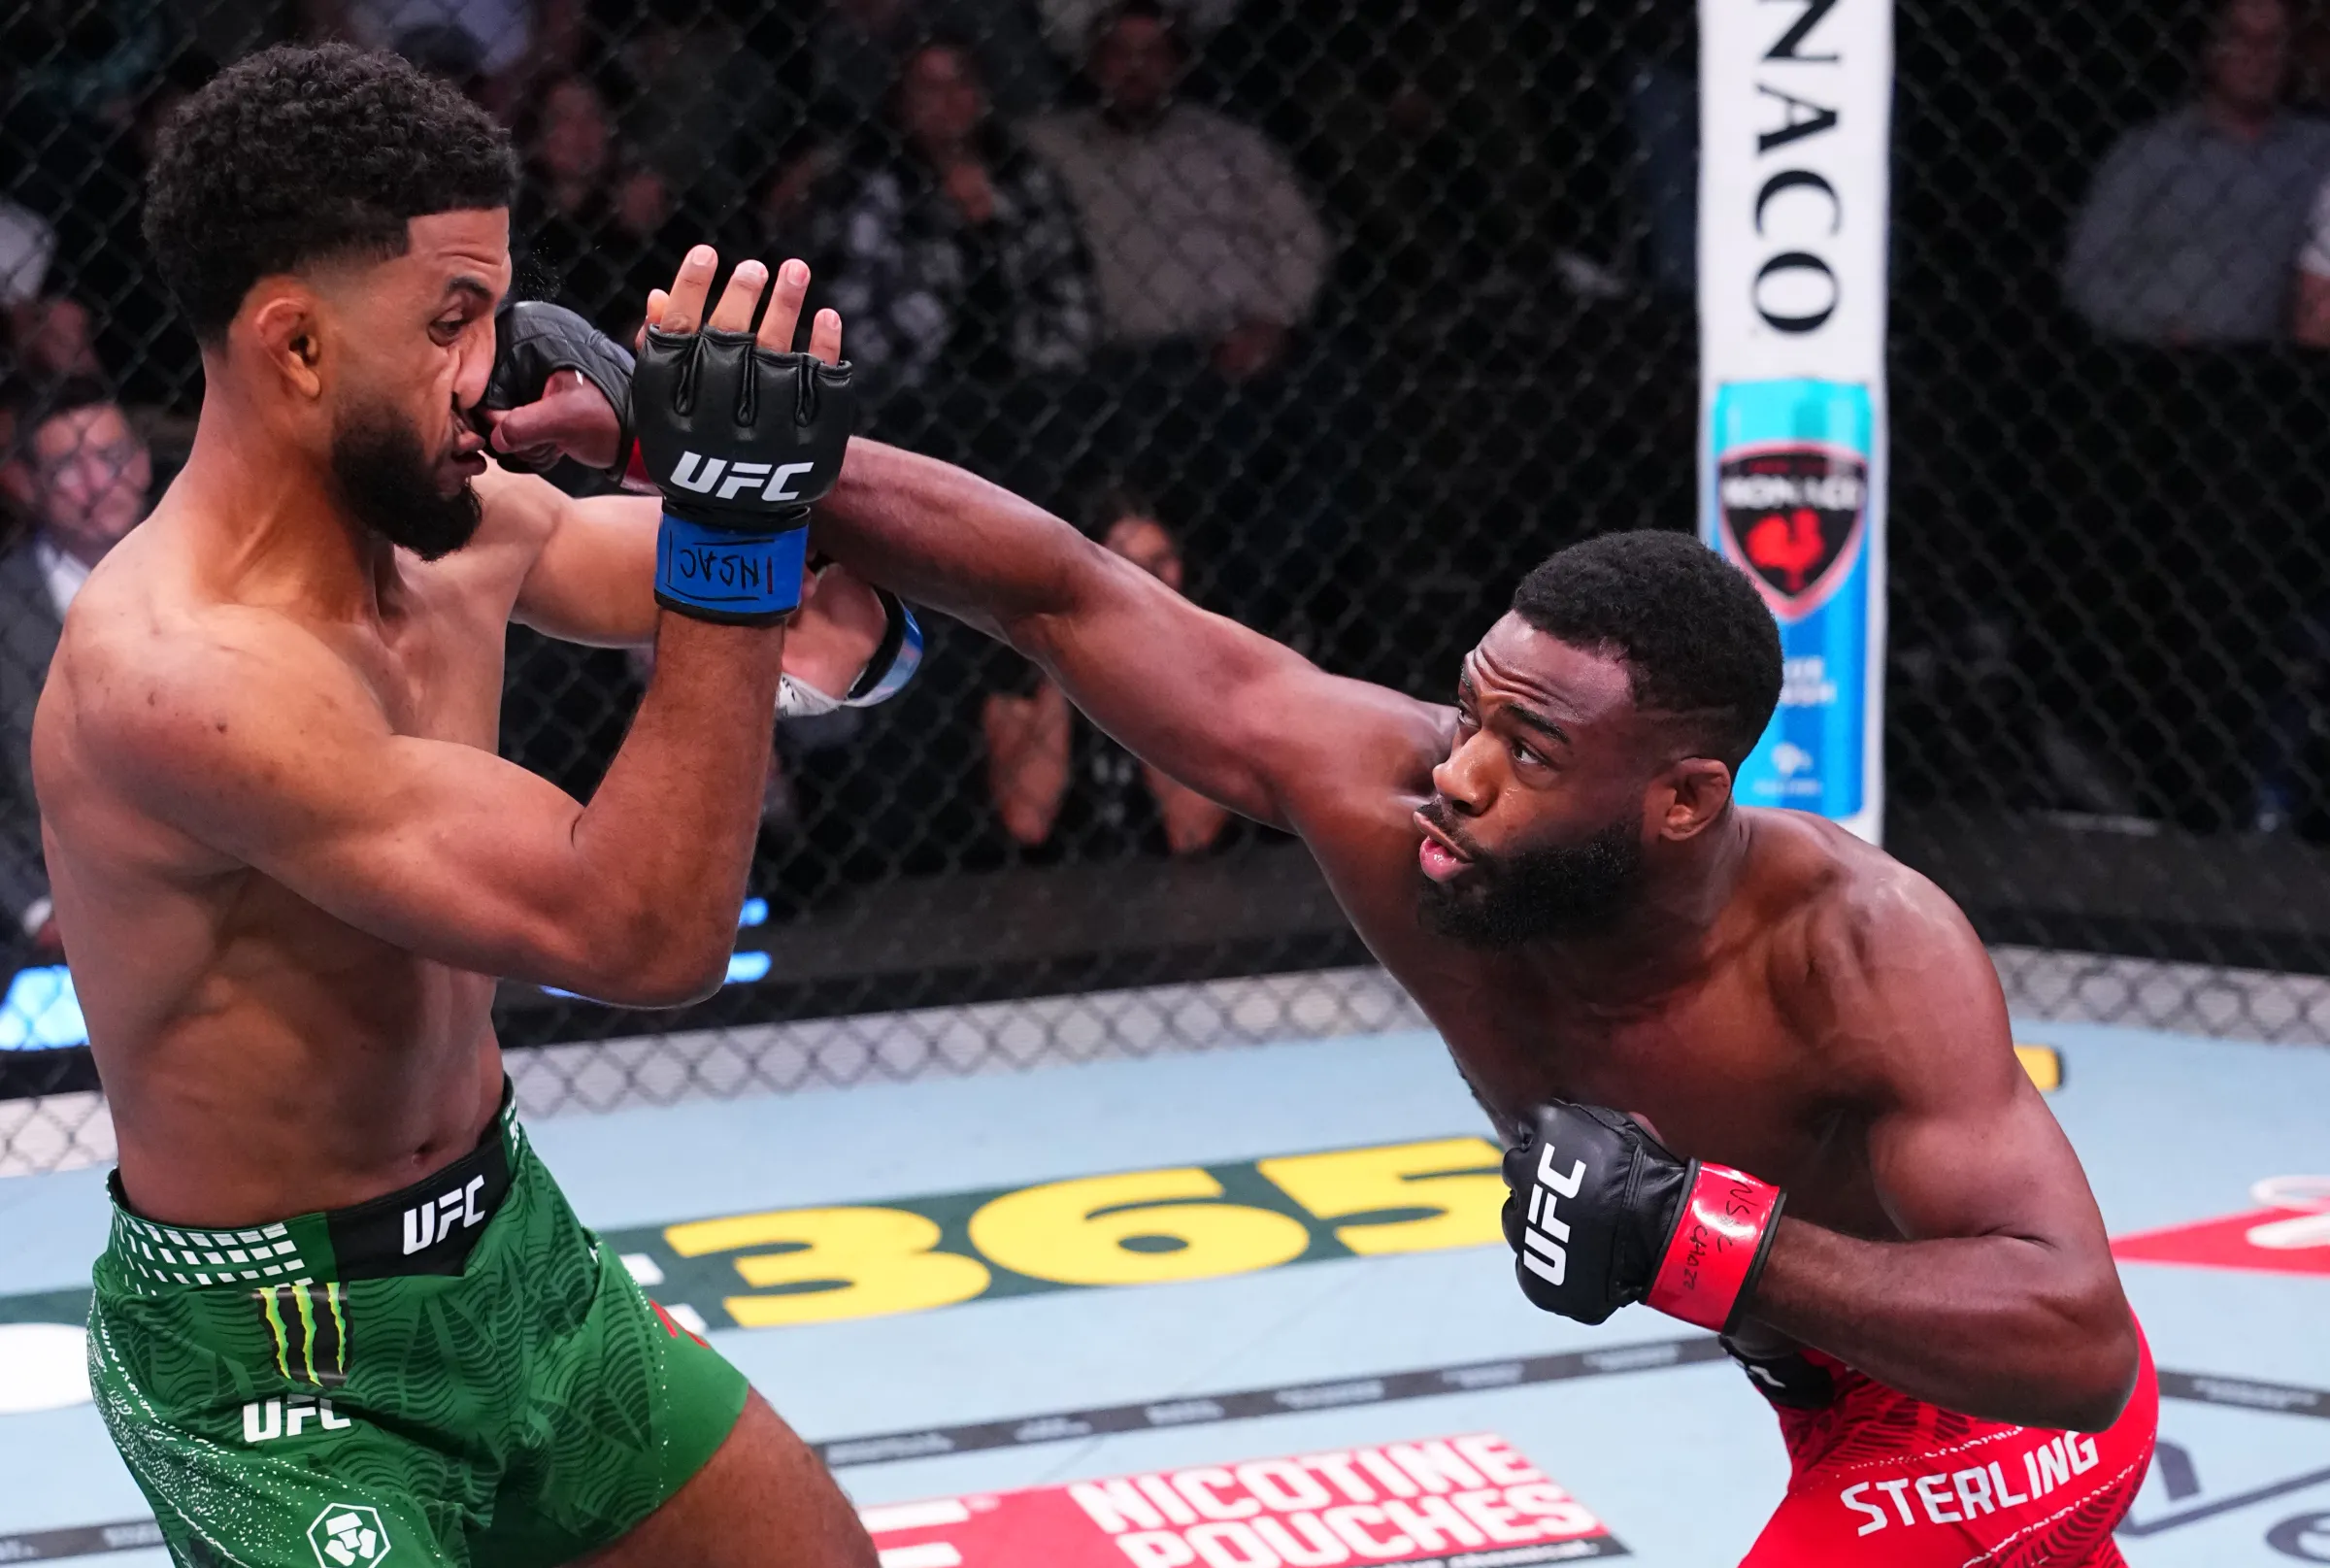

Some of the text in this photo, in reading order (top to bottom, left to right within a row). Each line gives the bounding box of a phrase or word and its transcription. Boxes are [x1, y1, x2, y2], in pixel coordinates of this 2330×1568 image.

[669, 450, 815, 503] UFC
[402, 1173, 486, 1256] UFC
[1522, 1141, 1587, 1287] UFC
[243, 1392, 352, 1444] UFC
[1067, 1432, 1546, 1535] NICOTINE
[1115, 1481, 1602, 1568] POUCHES
[1839, 1429, 2100, 1538] STERLING
